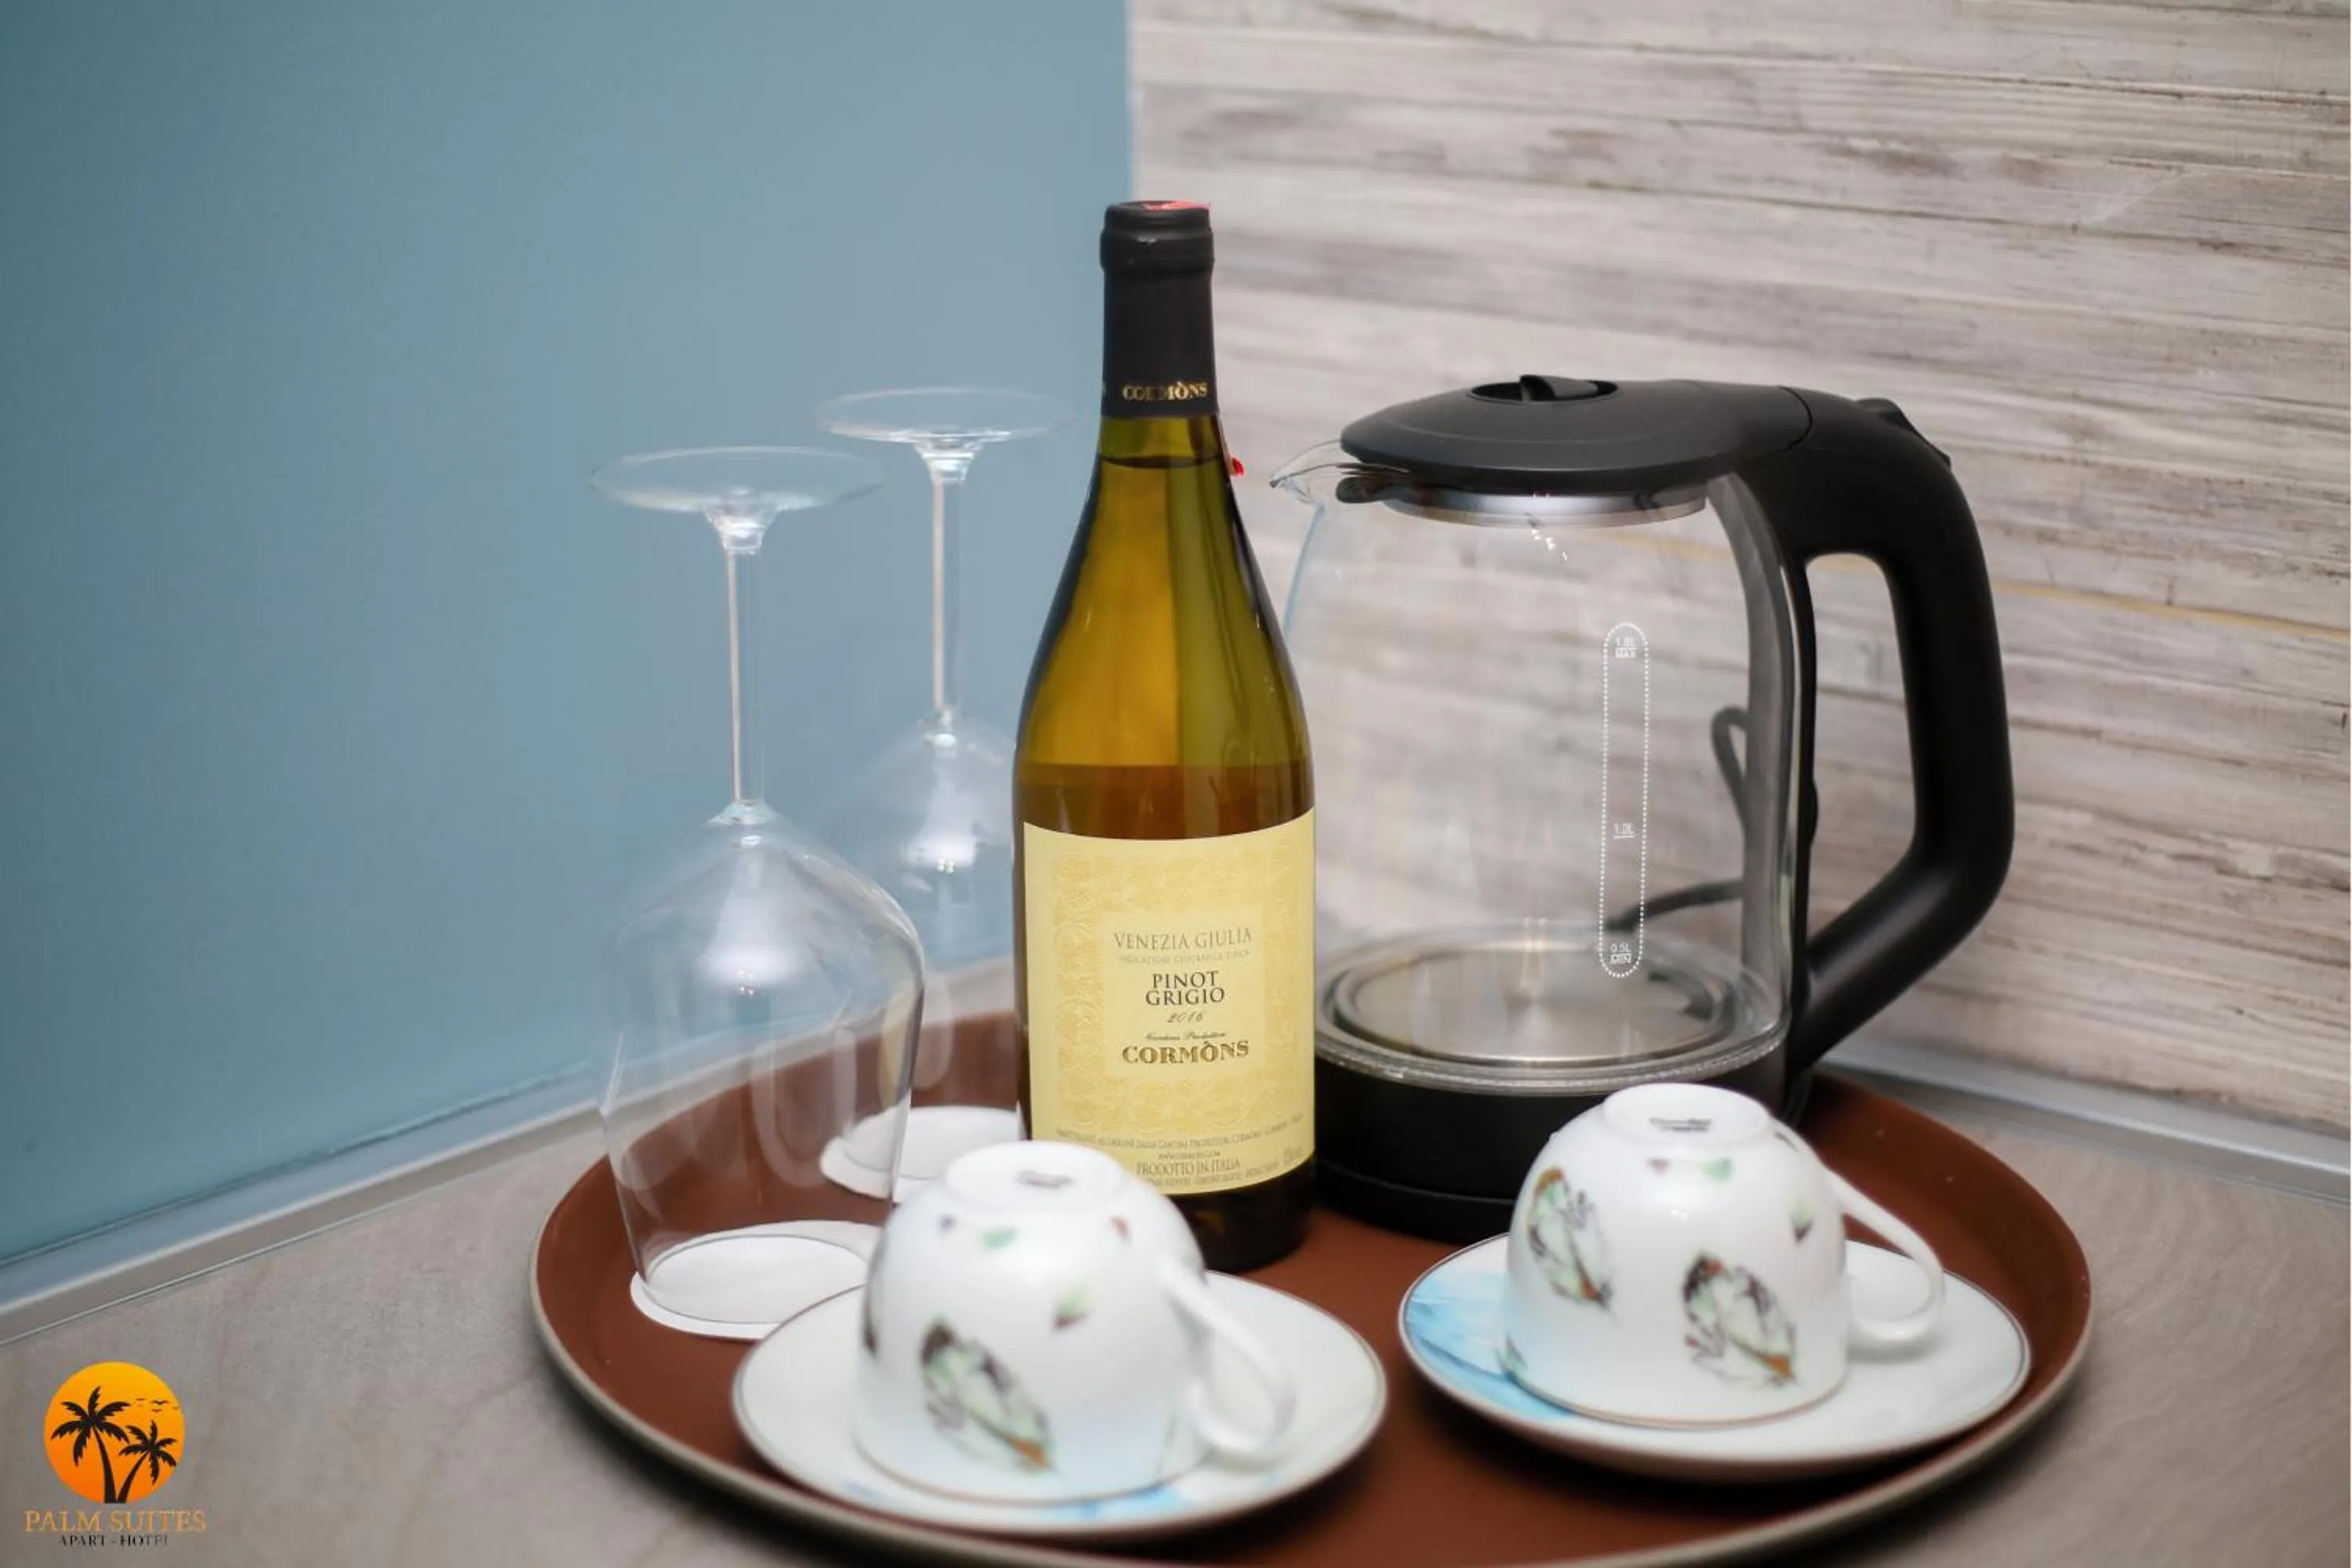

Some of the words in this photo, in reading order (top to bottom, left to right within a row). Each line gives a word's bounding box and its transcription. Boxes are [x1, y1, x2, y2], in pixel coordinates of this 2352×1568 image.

[1113, 932, 1190, 950] VENEZIA
[1196, 927, 1252, 948] GIULIA
[1153, 970, 1219, 989] PINOT
[1145, 988, 1225, 1006] GRIGIO
[1167, 1011, 1205, 1023] 2016
[1122, 1040, 1250, 1064] CORMÒNS
[1136, 1162, 1195, 1177] PRODOTTO
[1196, 1160, 1210, 1174] IN
[1211, 1157, 1240, 1173] ITALIA
